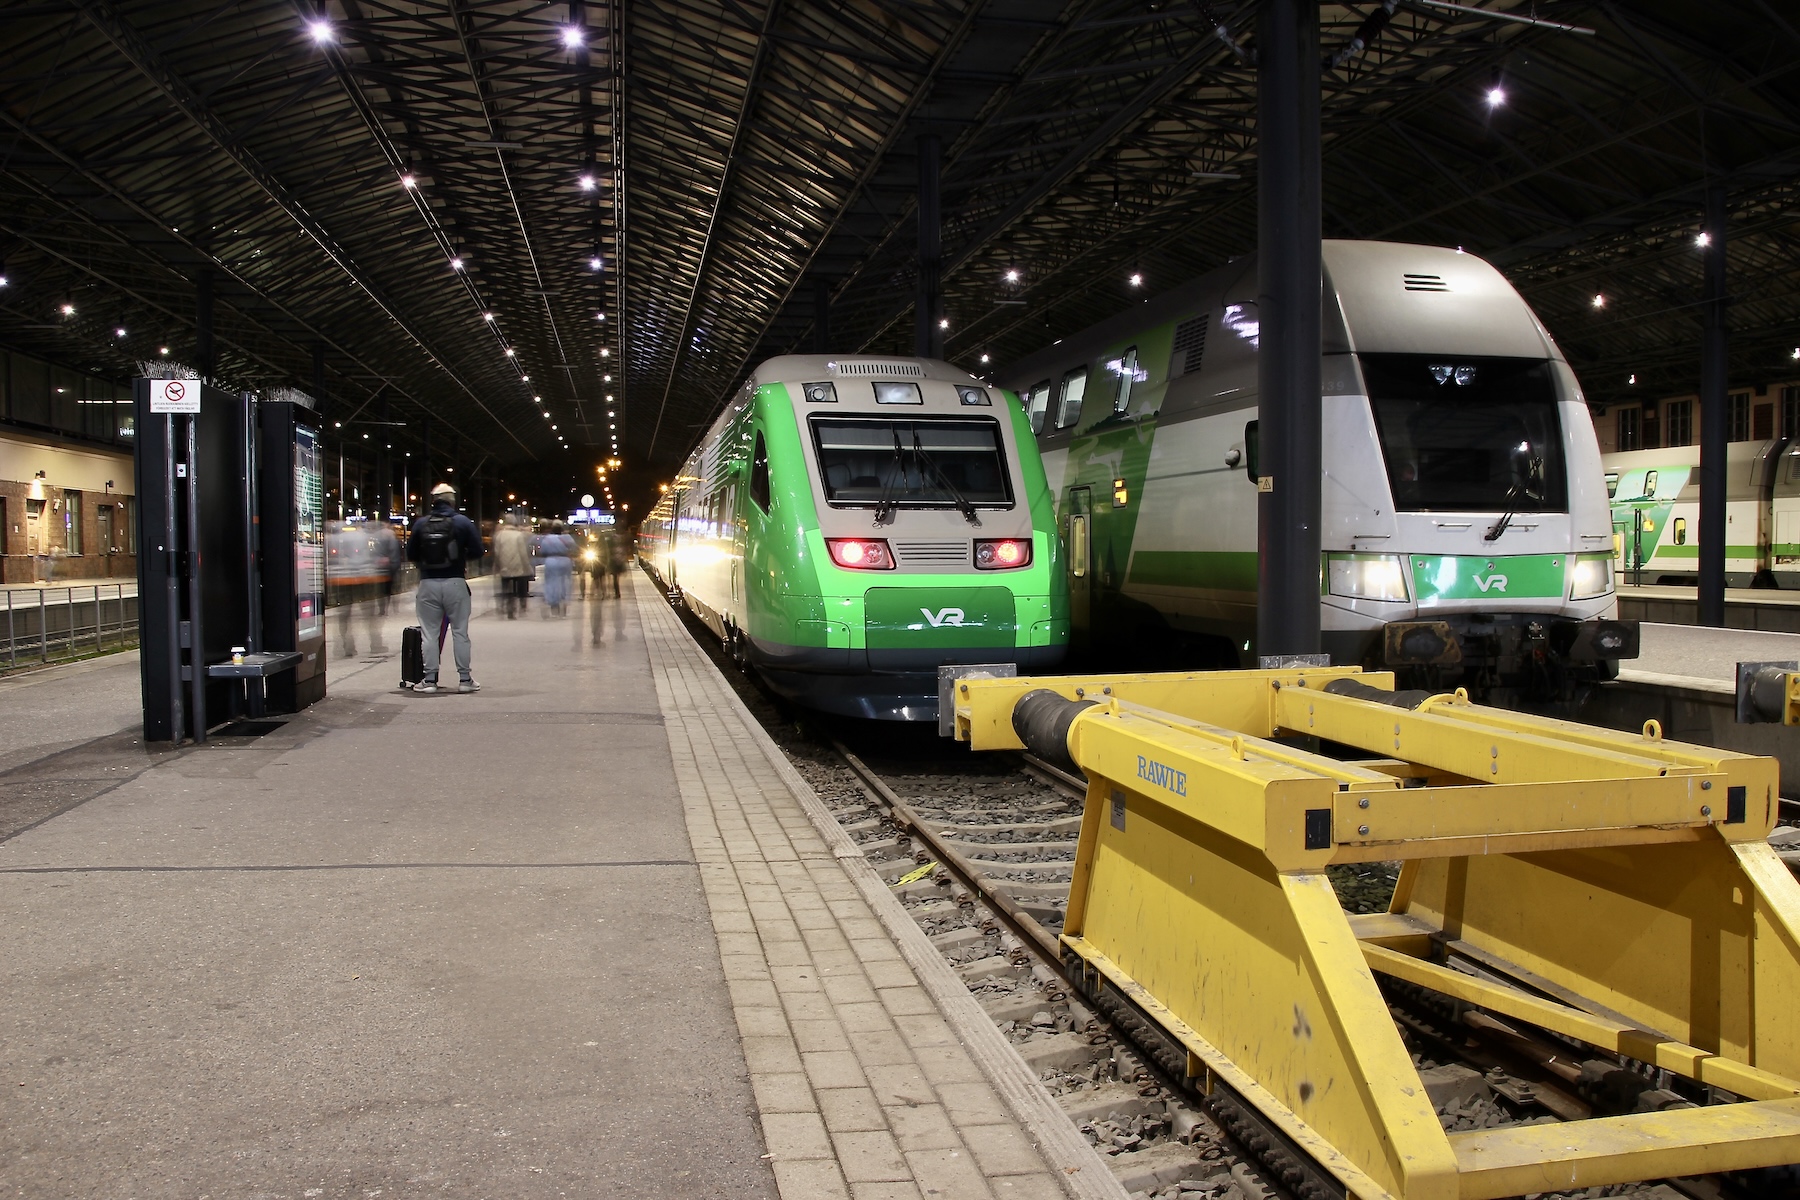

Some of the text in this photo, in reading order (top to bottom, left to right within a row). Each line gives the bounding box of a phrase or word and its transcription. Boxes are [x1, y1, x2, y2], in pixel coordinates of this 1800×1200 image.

[1471, 574, 1508, 592] VR
[919, 607, 965, 628] VR
[1136, 754, 1187, 798] RAWIE
